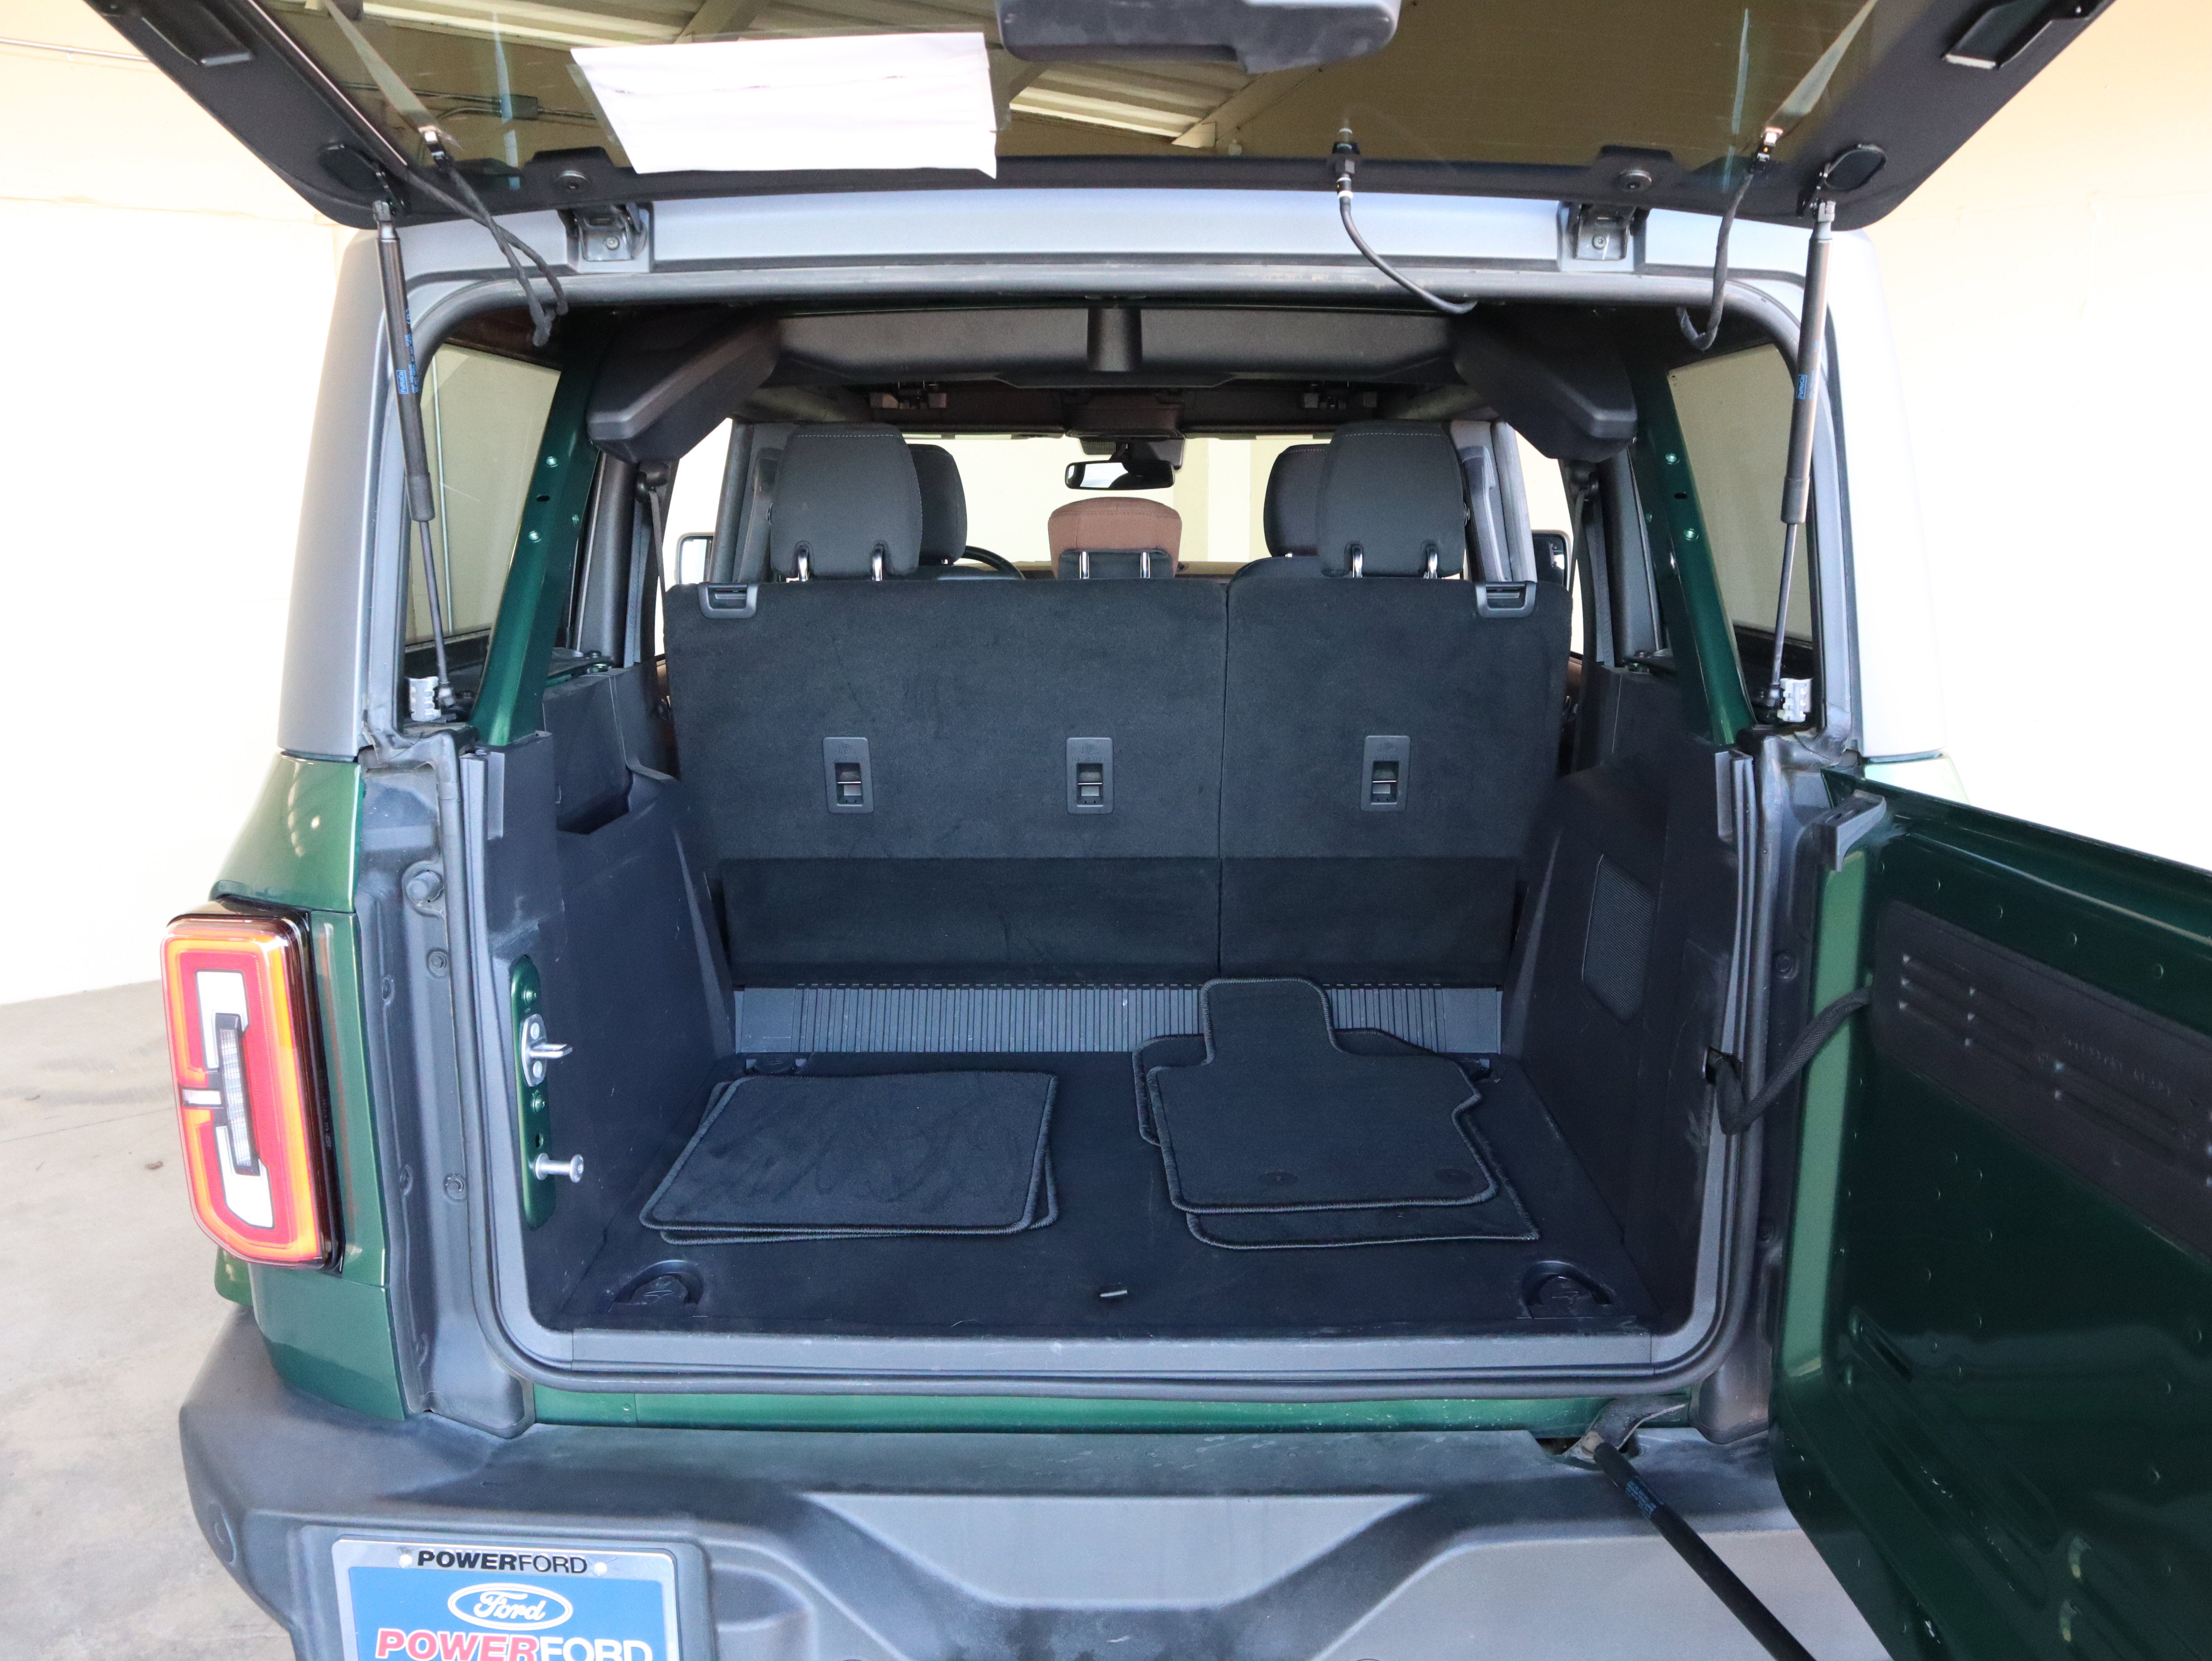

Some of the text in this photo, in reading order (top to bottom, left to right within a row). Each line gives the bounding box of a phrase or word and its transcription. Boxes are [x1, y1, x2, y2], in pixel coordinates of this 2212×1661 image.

[418, 1551, 588, 1574] POWERFORD
[473, 1590, 547, 1621] Ford
[376, 1628, 653, 1661] POWERFORD
